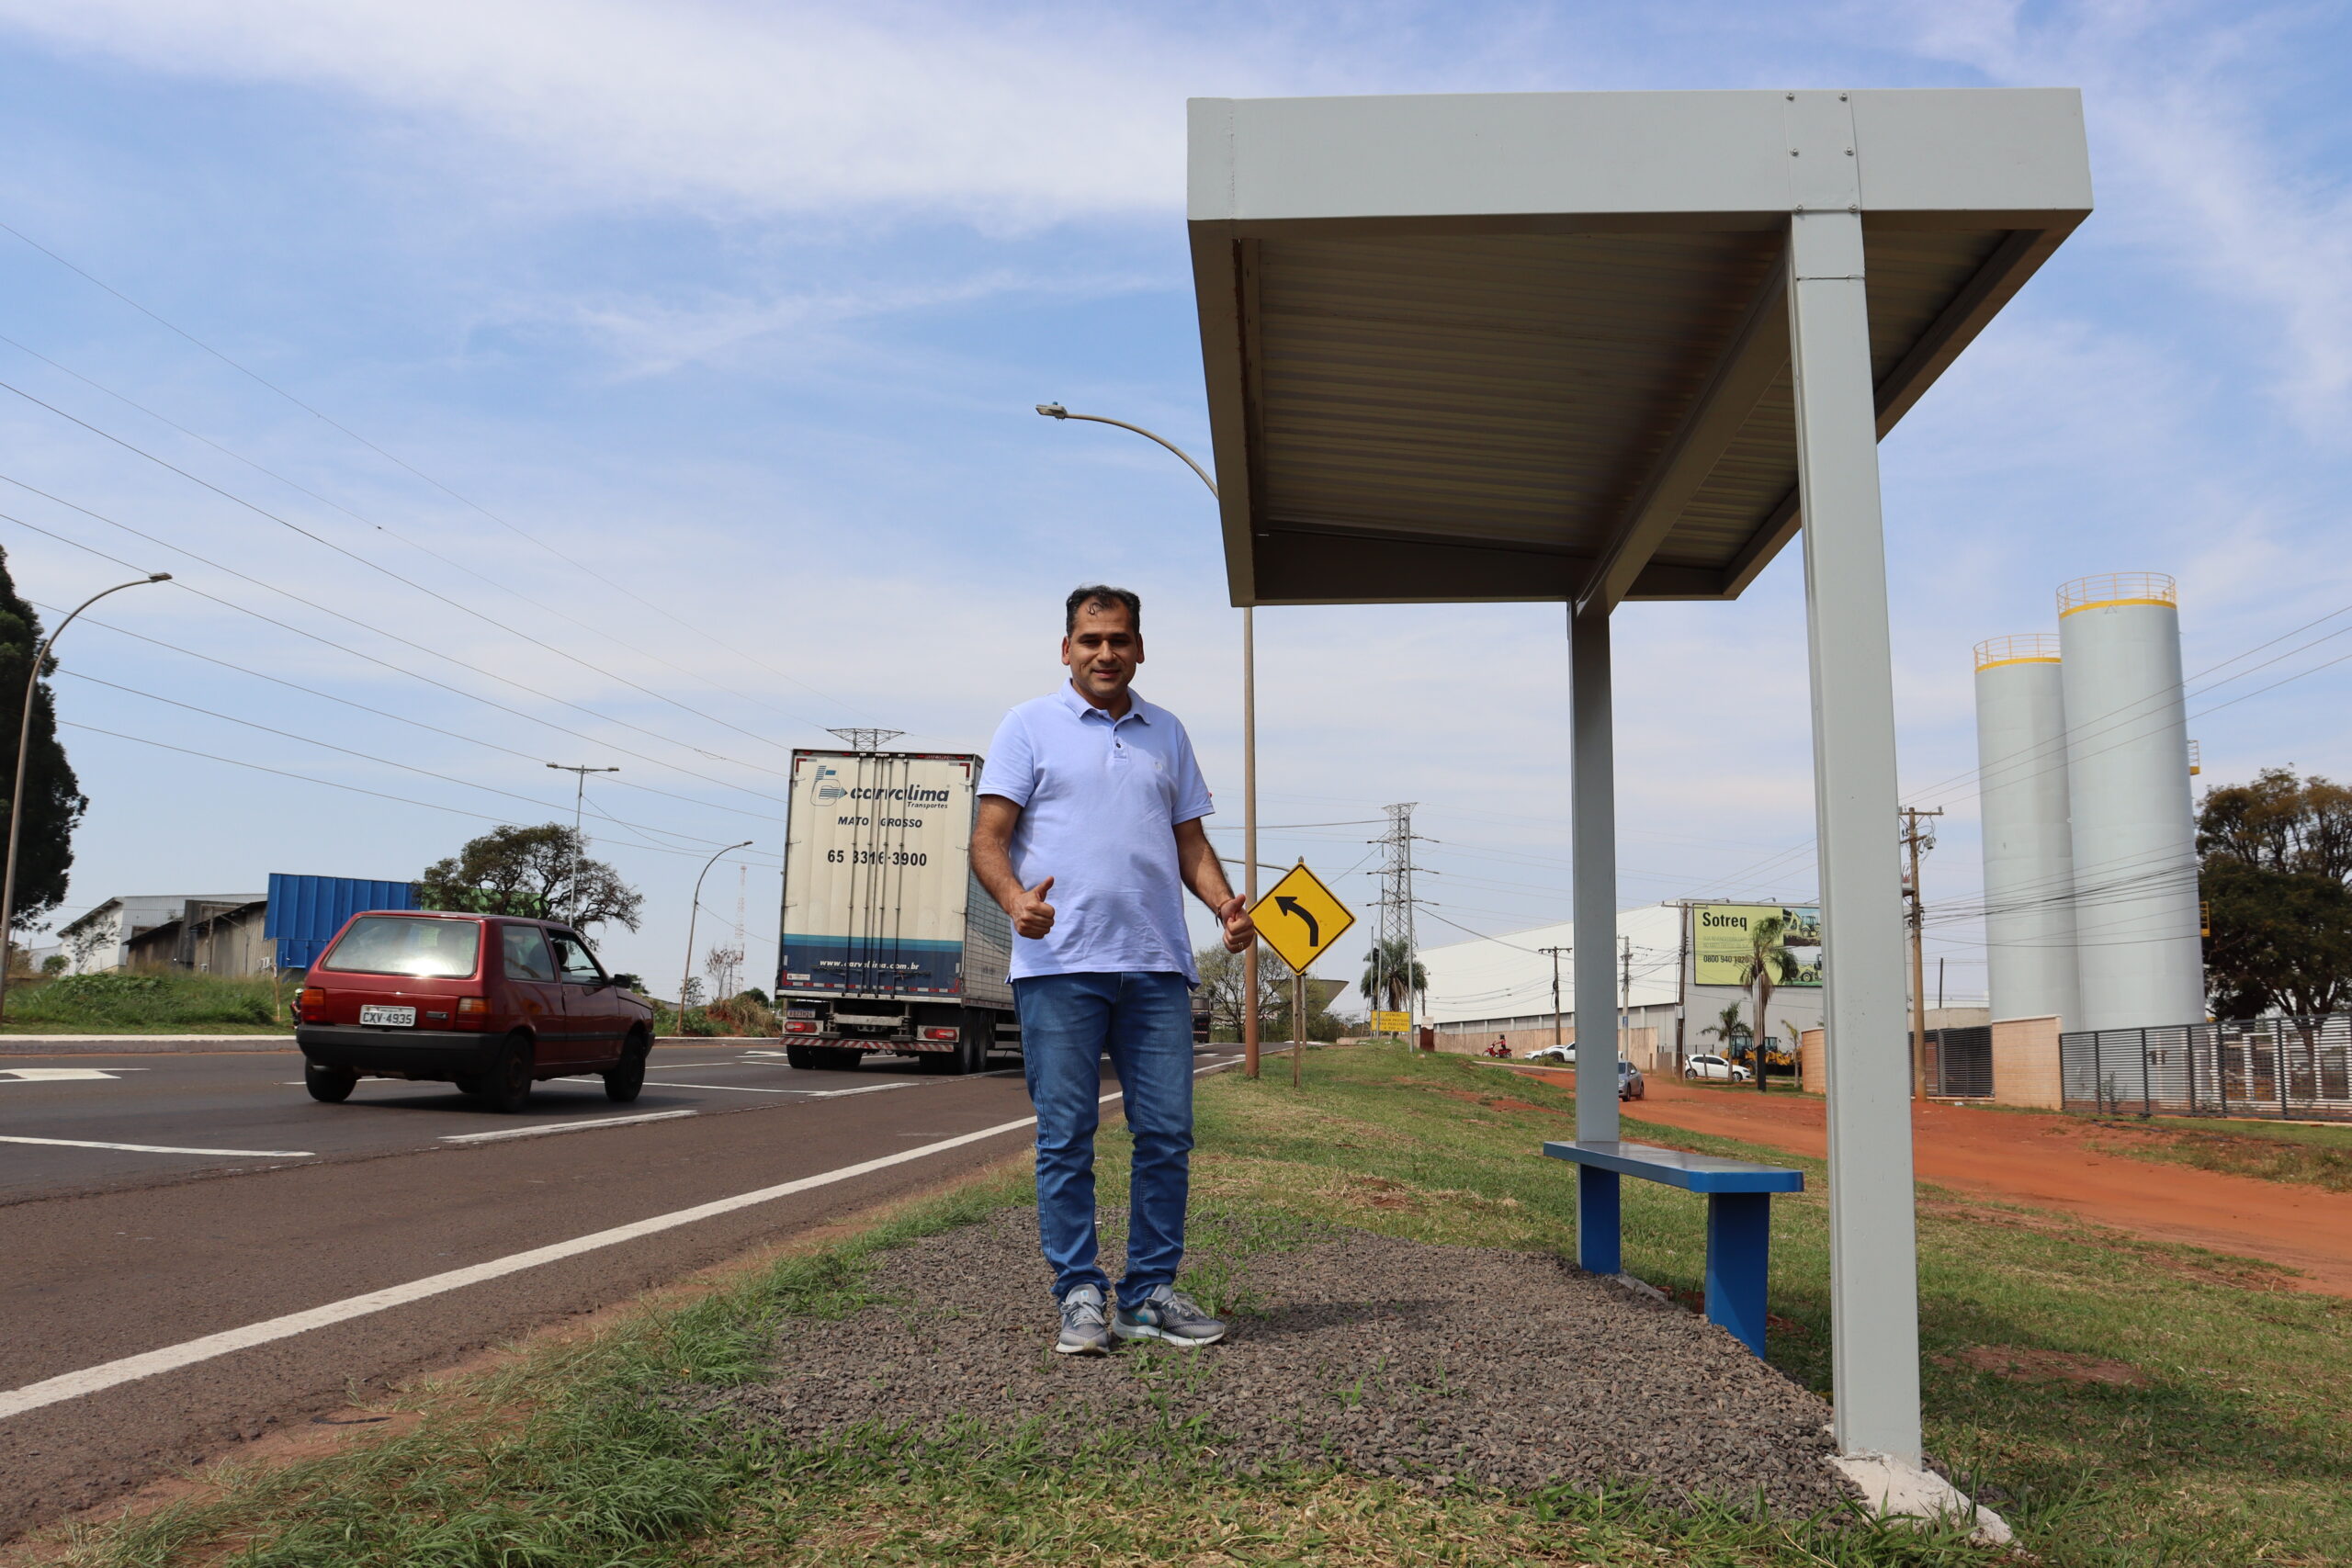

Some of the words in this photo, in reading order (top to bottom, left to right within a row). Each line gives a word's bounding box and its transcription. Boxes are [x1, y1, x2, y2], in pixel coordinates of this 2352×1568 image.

[850, 784, 949, 802] carvalima
[907, 801, 948, 809] Transportes
[838, 817, 869, 826] MATO
[880, 818, 922, 828] GROSSO
[828, 850, 844, 863] 65
[853, 851, 927, 866] 3316-3900
[1702, 912, 1747, 931] Sotreq
